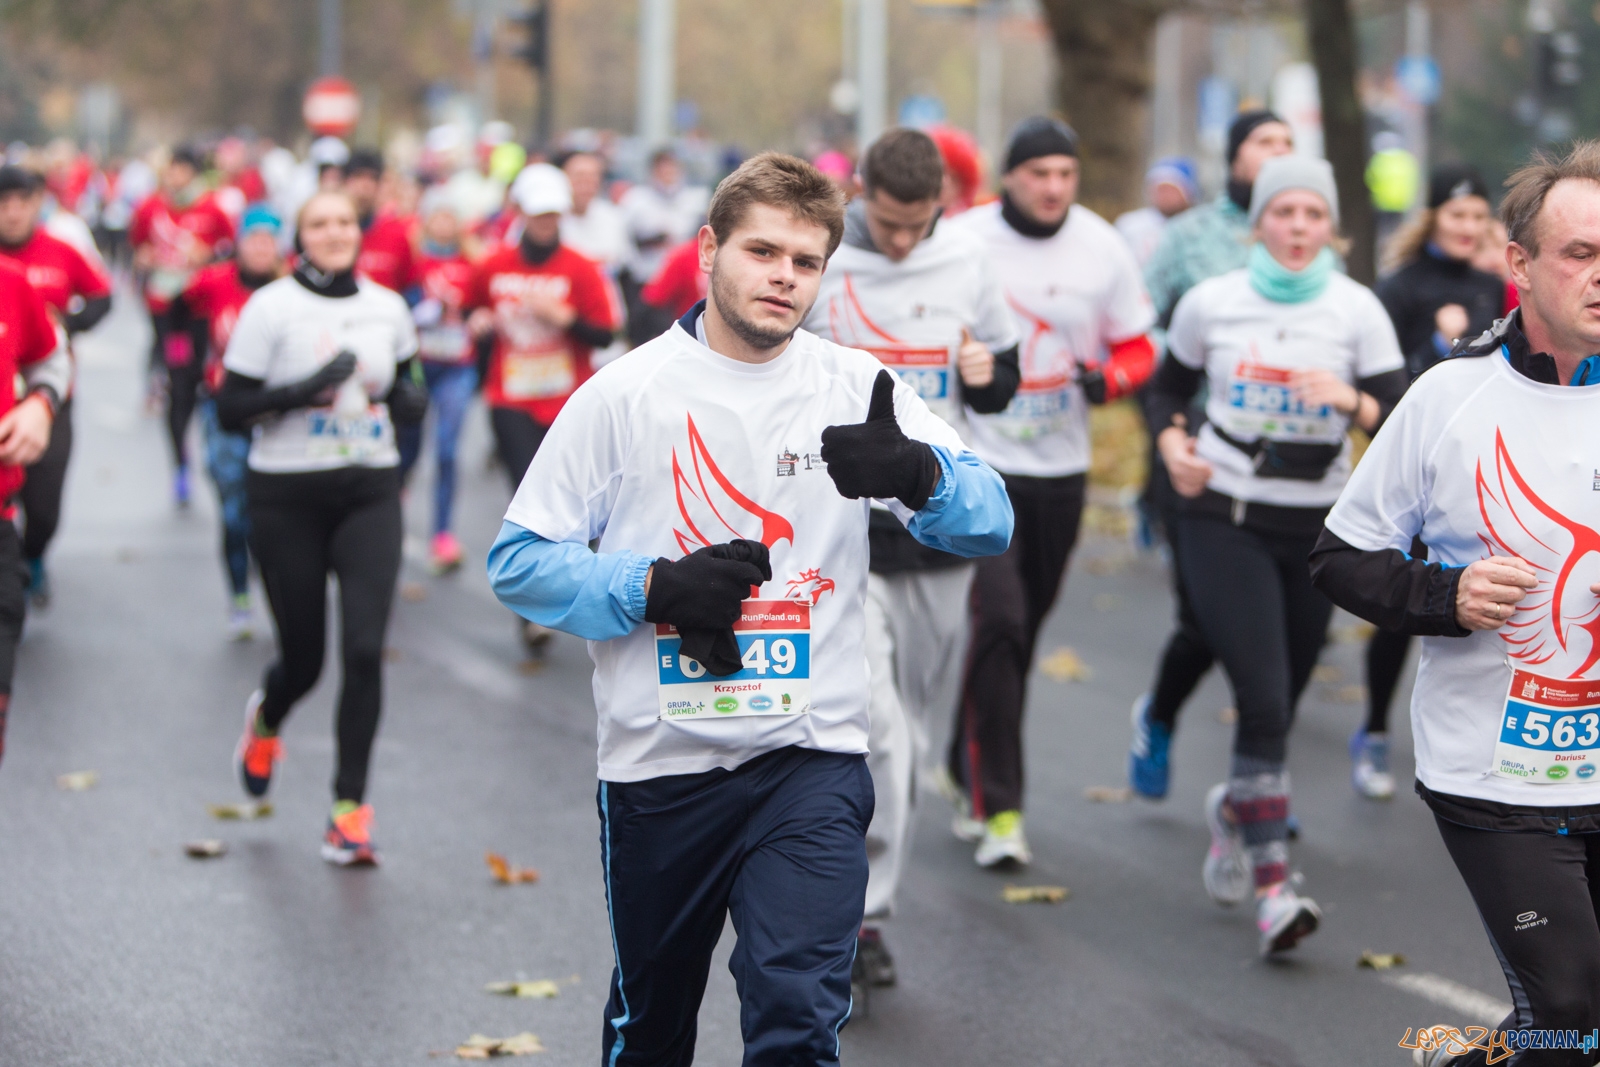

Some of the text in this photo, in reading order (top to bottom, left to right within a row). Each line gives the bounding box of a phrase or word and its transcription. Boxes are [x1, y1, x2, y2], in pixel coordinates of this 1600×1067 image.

[741, 613, 801, 623] RunPoland.org
[661, 655, 673, 668] E
[714, 683, 762, 694] Krzysztof
[667, 701, 692, 709] GRUPA
[667, 707, 697, 716] LUXMED
[1506, 716, 1518, 730] E
[1501, 759, 1525, 770] GRUPA
[1500, 766, 1529, 777] LUXMED
[1514, 917, 1548, 932] Kalenji
